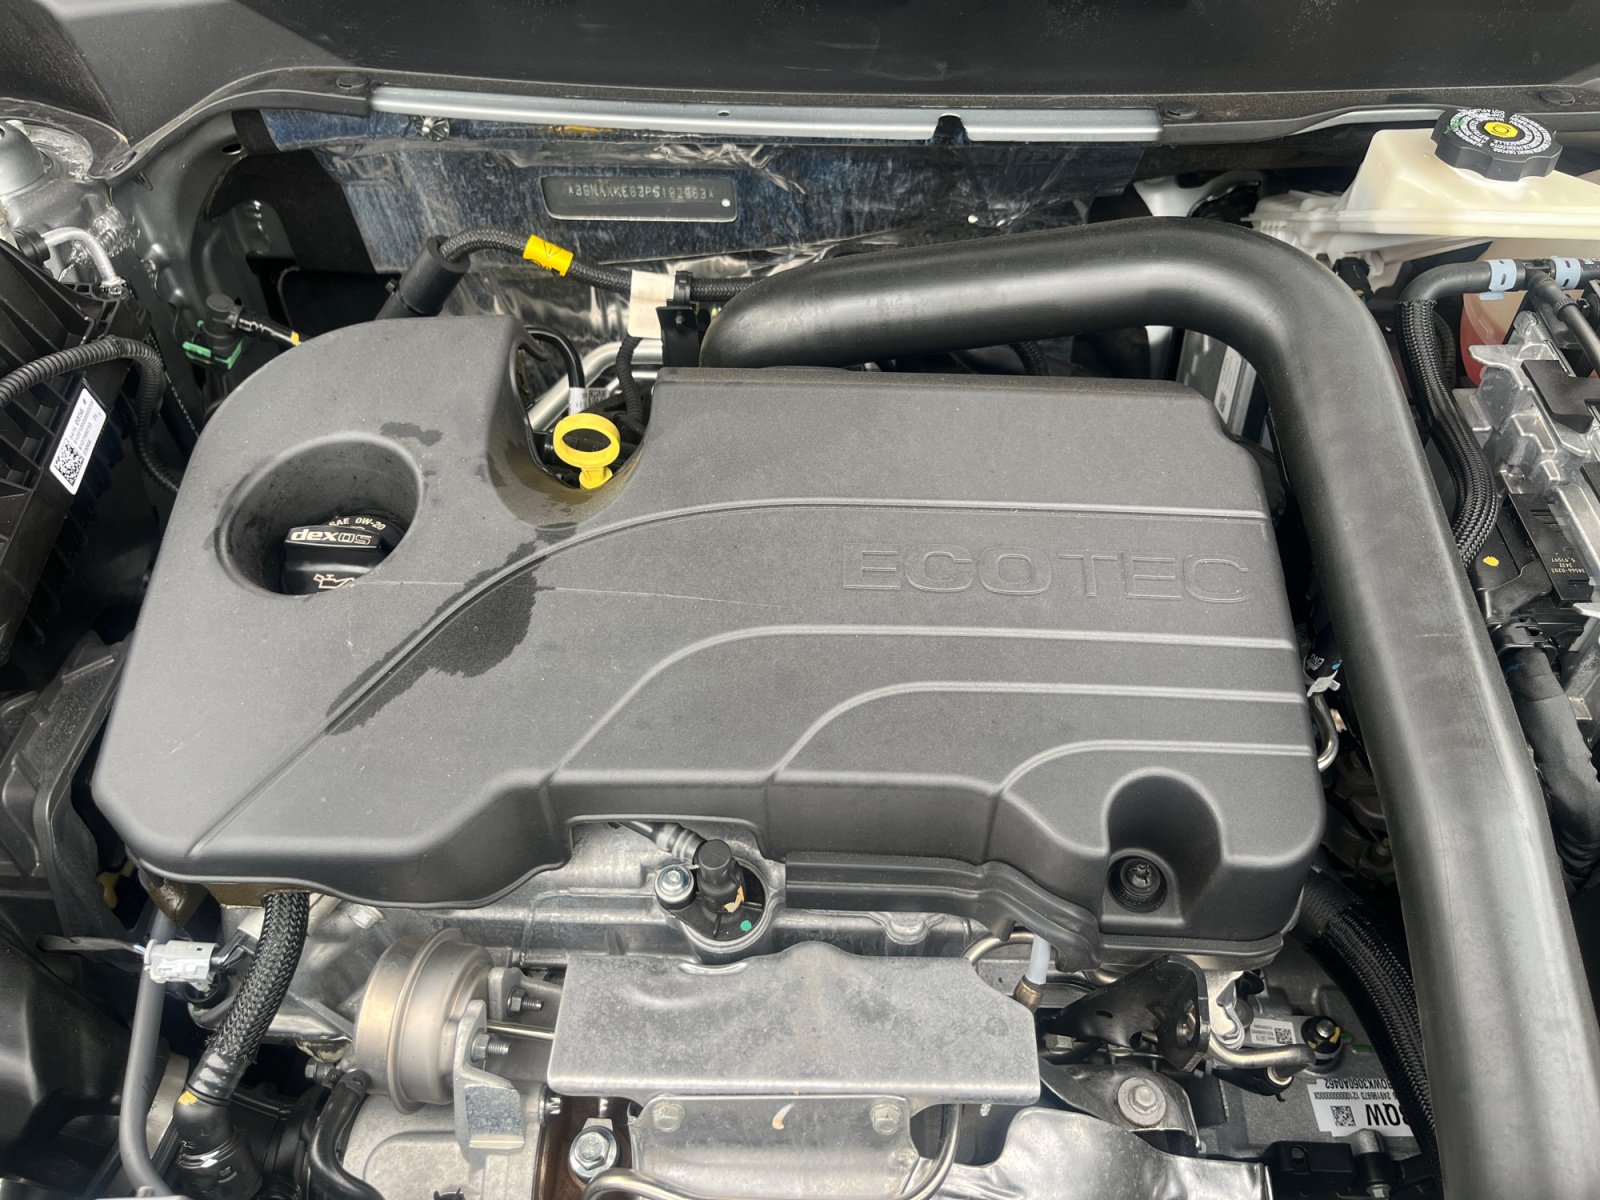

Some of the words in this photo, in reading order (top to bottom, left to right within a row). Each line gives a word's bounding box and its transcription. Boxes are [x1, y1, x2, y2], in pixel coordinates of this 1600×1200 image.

[328, 517, 350, 527] SAE
[355, 517, 386, 530] 0W-20
[290, 529, 372, 545] dexos
[843, 543, 1250, 604] ECOTEC
[1366, 1102, 1408, 1126] QW
